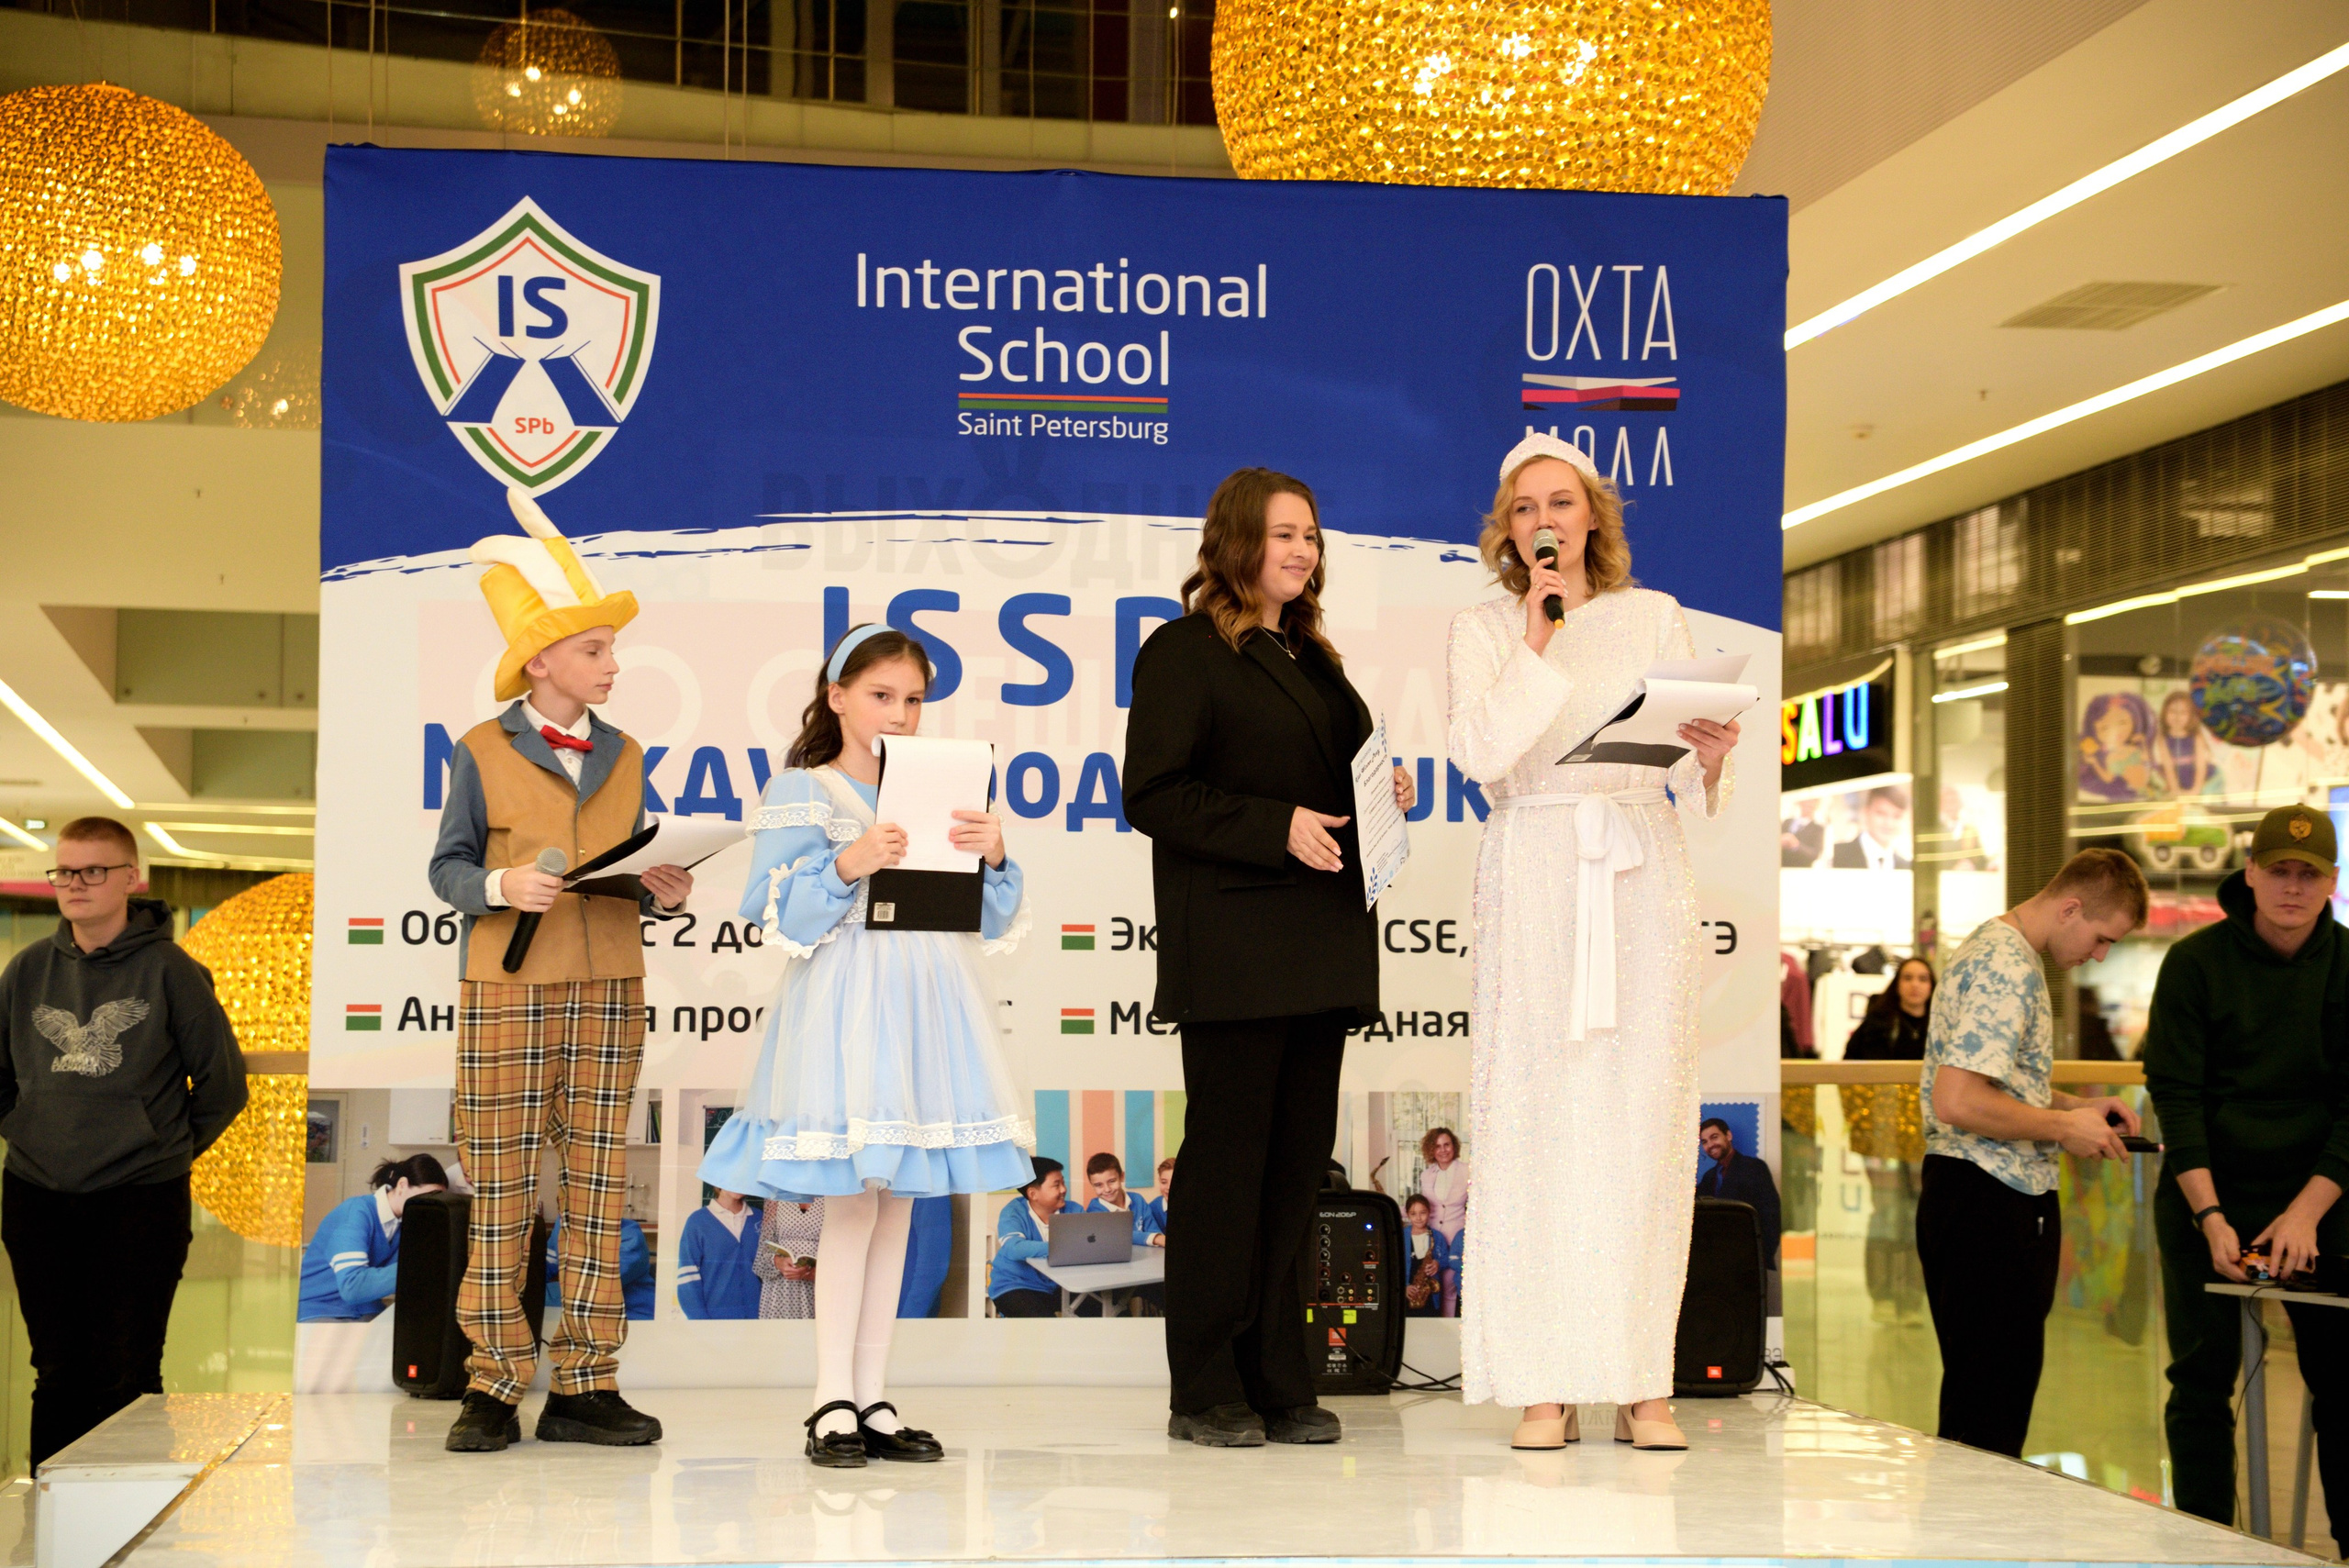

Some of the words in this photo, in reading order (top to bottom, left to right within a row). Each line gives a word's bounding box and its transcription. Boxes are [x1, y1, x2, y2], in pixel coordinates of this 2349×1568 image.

[498, 275, 568, 339] IS
[857, 252, 1267, 318] International
[1526, 263, 1678, 361] ОХТА
[958, 325, 1169, 385] School
[515, 417, 554, 435] SPb
[958, 412, 1023, 437] Saint
[1030, 414, 1169, 446] Petersburg
[1525, 425, 1674, 486] ОЛЛ
[1781, 681, 1870, 765] SALU
[673, 912, 696, 947] 2
[1384, 919, 1468, 958] CSE,
